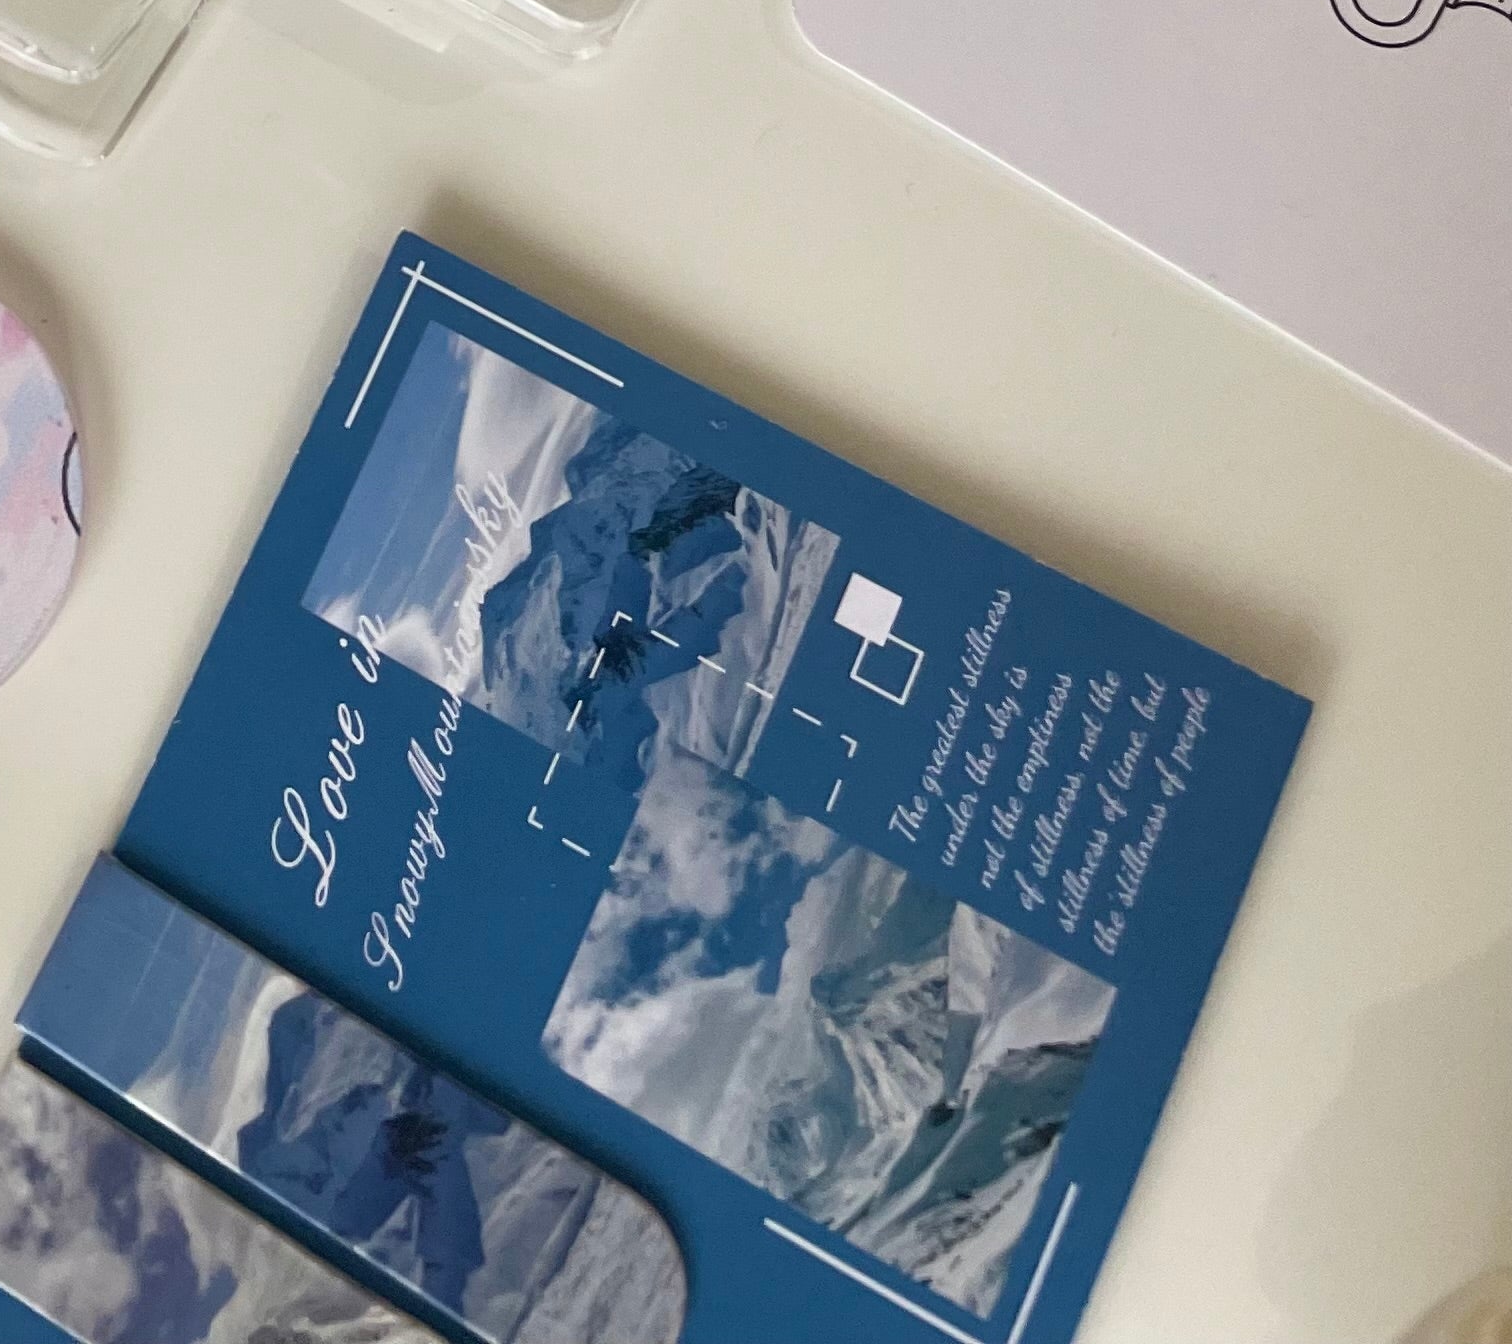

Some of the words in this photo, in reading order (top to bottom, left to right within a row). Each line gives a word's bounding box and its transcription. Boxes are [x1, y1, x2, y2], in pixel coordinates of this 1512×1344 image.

[1003, 666, 1028, 690] is
[1088, 669, 1121, 713] the
[888, 795, 928, 842] The
[922, 687, 970, 797] greatest
[961, 588, 1011, 688] stillness
[985, 695, 1022, 740] sky
[1016, 672, 1073, 793] emptiness
[1078, 711, 1103, 762] not
[1170, 686, 1211, 771] people
[271, 703, 364, 907] Love
[338, 614, 388, 683] in
[964, 743, 998, 786] the
[1154, 756, 1187, 797] of
[991, 796, 1024, 840] the
[1057, 828, 1109, 934] stillness
[1096, 782, 1128, 823] of
[1130, 671, 1167, 722] but
[941, 792, 979, 867] under
[981, 838, 1006, 889] not
[1115, 802, 1168, 909] stillness
[1013, 869, 1045, 912] of
[1093, 909, 1126, 957] the
